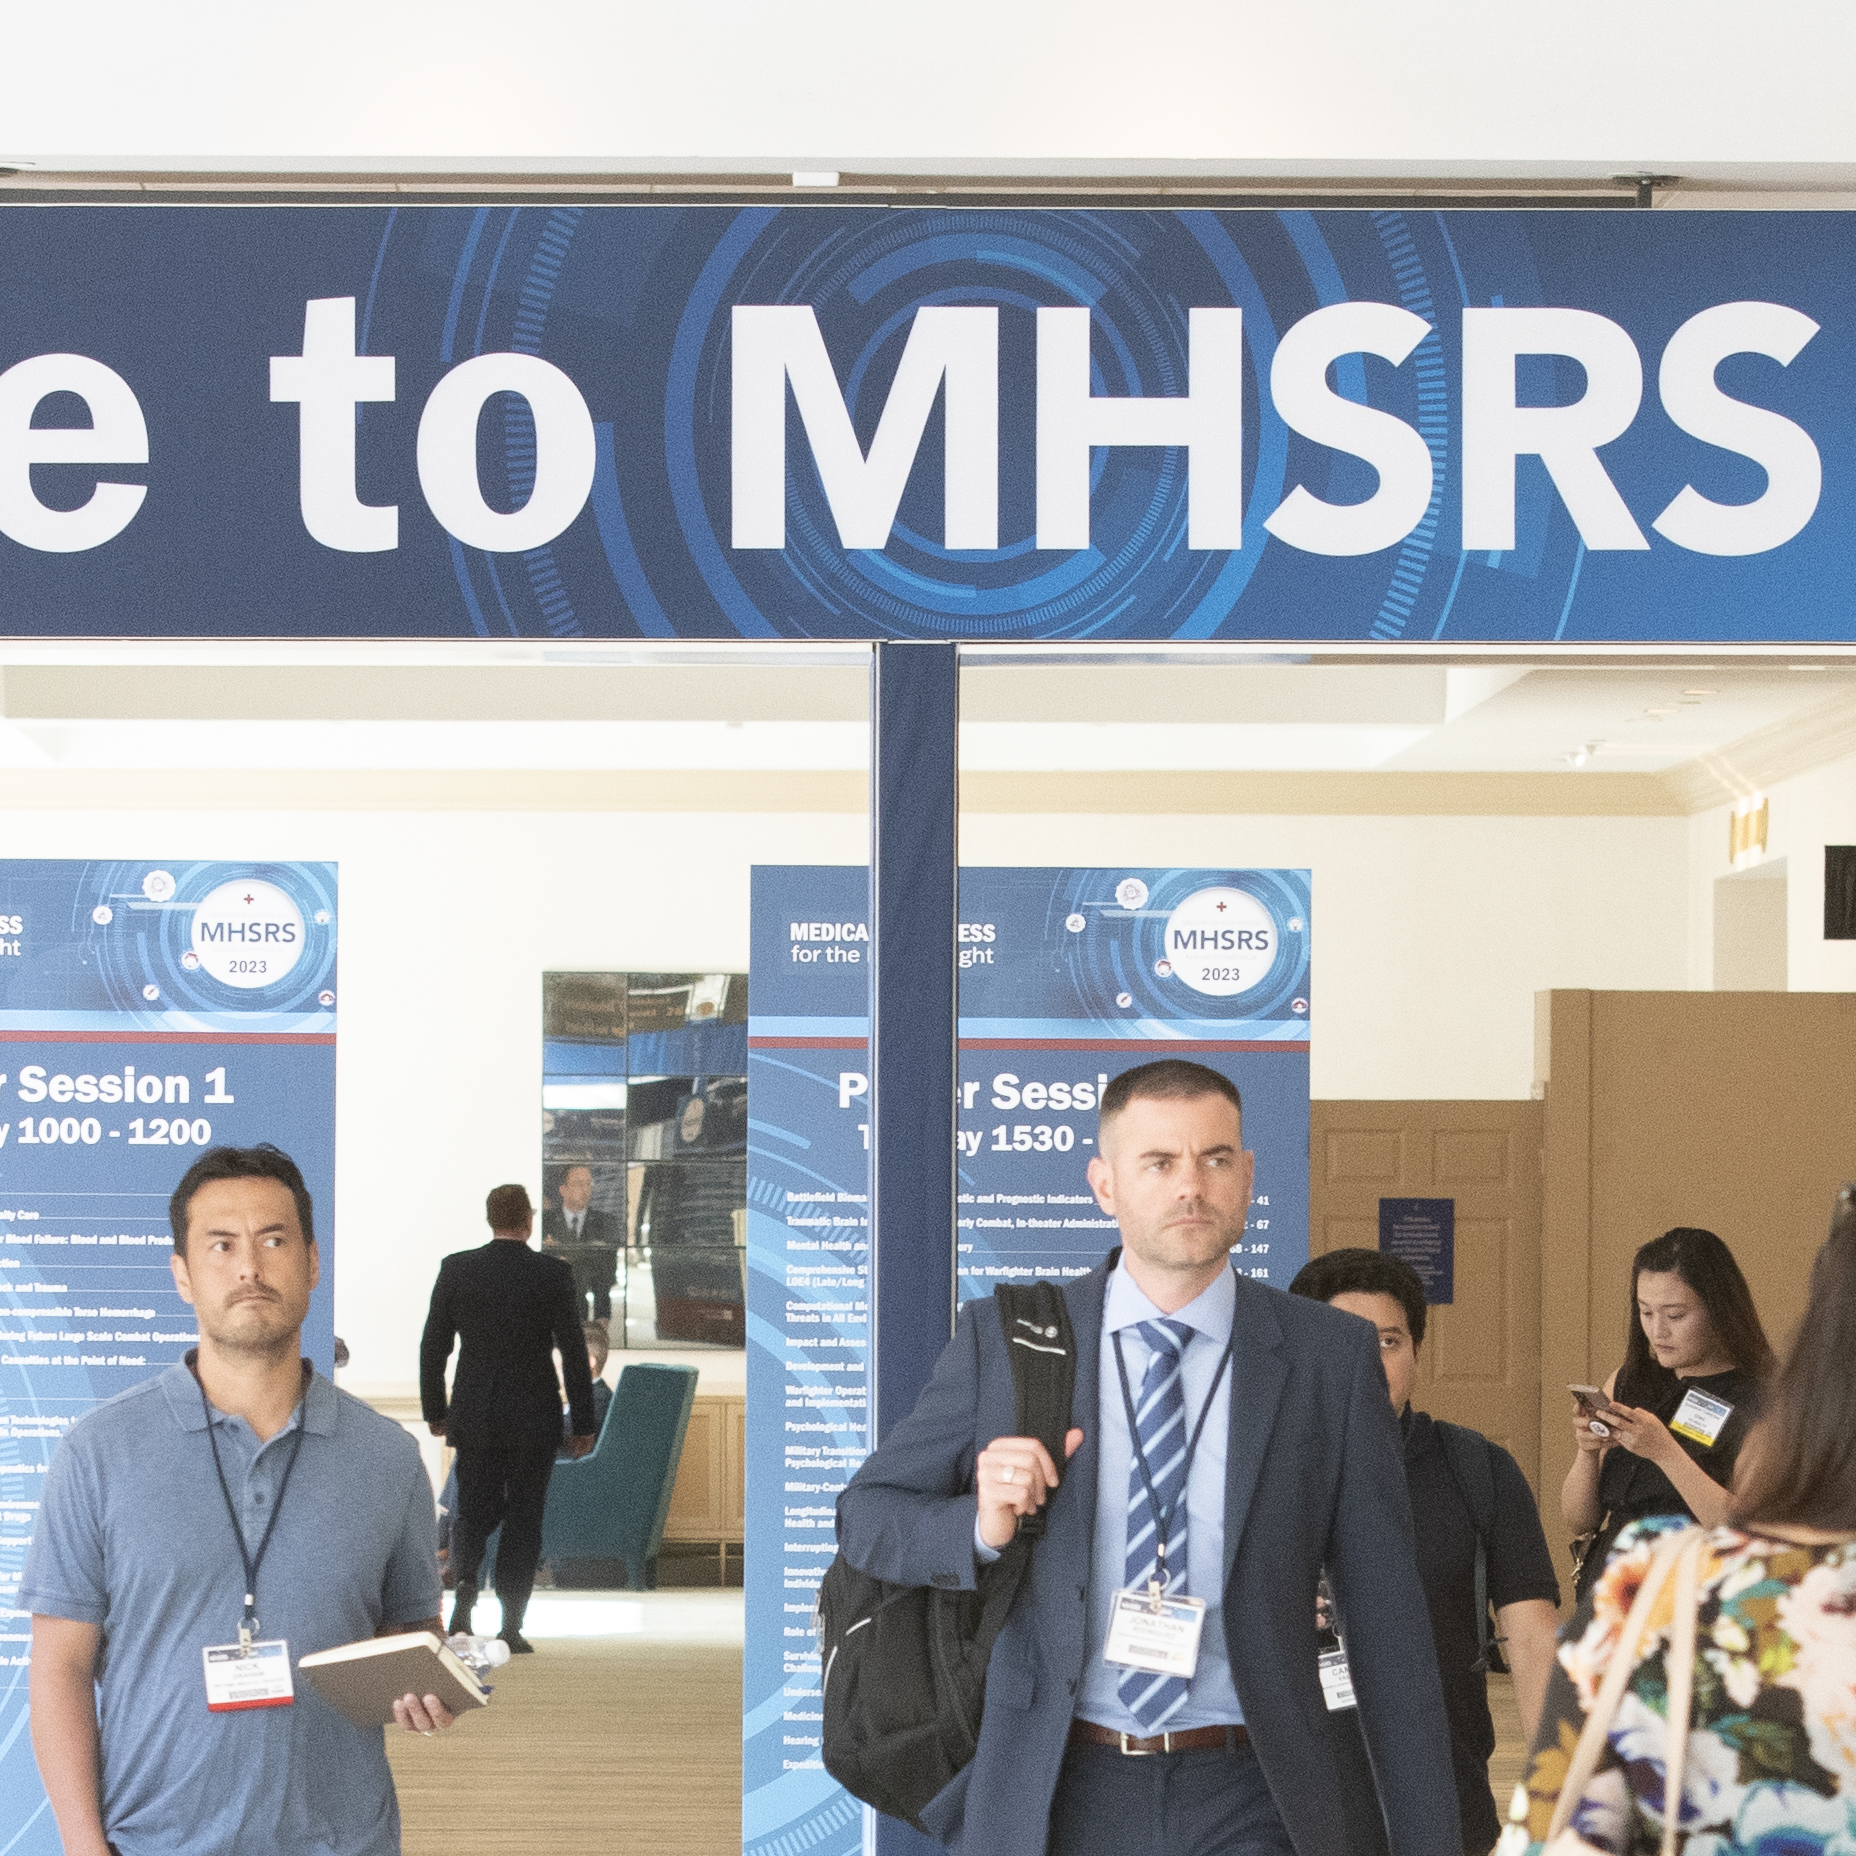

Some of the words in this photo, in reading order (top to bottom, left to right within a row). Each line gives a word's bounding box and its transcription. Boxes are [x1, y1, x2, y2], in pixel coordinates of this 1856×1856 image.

[270, 296, 596, 552] to
[732, 301, 1822, 556] MHSRS
[200, 922, 296, 943] MHSRS
[790, 922, 869, 942] MEDICA
[1173, 929, 1269, 951] MHSRS
[791, 944, 822, 963] for
[825, 945, 860, 963] the
[959, 946, 994, 968] ght
[228, 959, 268, 974] 2023
[1201, 967, 1241, 982] 2023
[18, 1065, 189, 1103] Session
[204, 1067, 234, 1103] 1
[990, 1072, 1108, 1111] Sessi
[18, 1117, 102, 1144] 1000
[128, 1118, 211, 1145] 1200
[991, 1124, 1075, 1152] 1530
[1256, 1195, 1269, 1206] 41
[1256, 1219, 1270, 1230] 67
[1251, 1243, 1270, 1254] 147
[1061, 1266, 1092, 1277] Healt
[1250, 1267, 1269, 1278] 161
